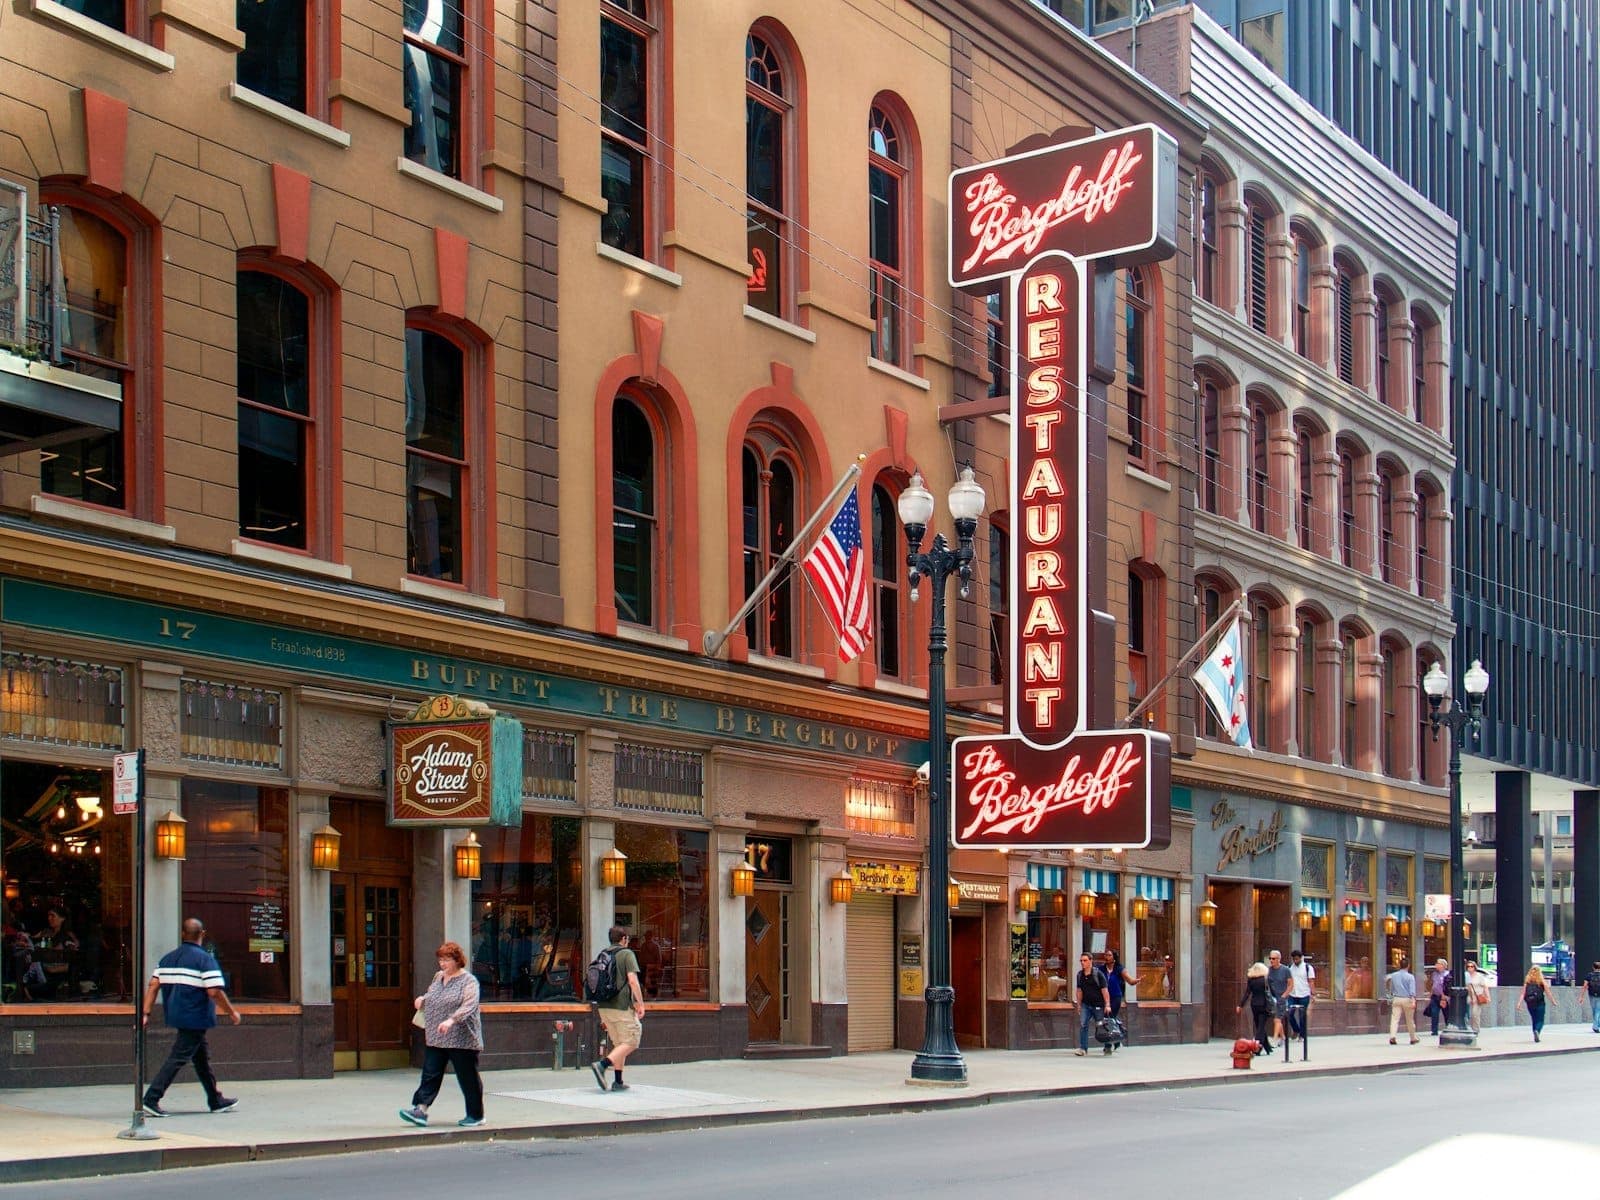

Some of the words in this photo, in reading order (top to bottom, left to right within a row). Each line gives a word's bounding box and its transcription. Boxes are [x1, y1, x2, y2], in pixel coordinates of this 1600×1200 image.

[962, 140, 1143, 272] Berghoff
[965, 172, 1007, 212] The
[1023, 274, 1066, 728] RESTAURANT
[159, 617, 198, 640] 17
[271, 637, 322, 658] Established
[411, 659, 550, 699] BUFFET
[598, 687, 678, 721] THE
[715, 706, 899, 756] BERGHOFF
[411, 742, 473, 773] Adams
[964, 745, 1005, 780] The
[415, 767, 469, 796] Street
[960, 741, 1141, 839] Berghoff
[1211, 799, 1236, 831] The
[744, 843, 769, 873] 17
